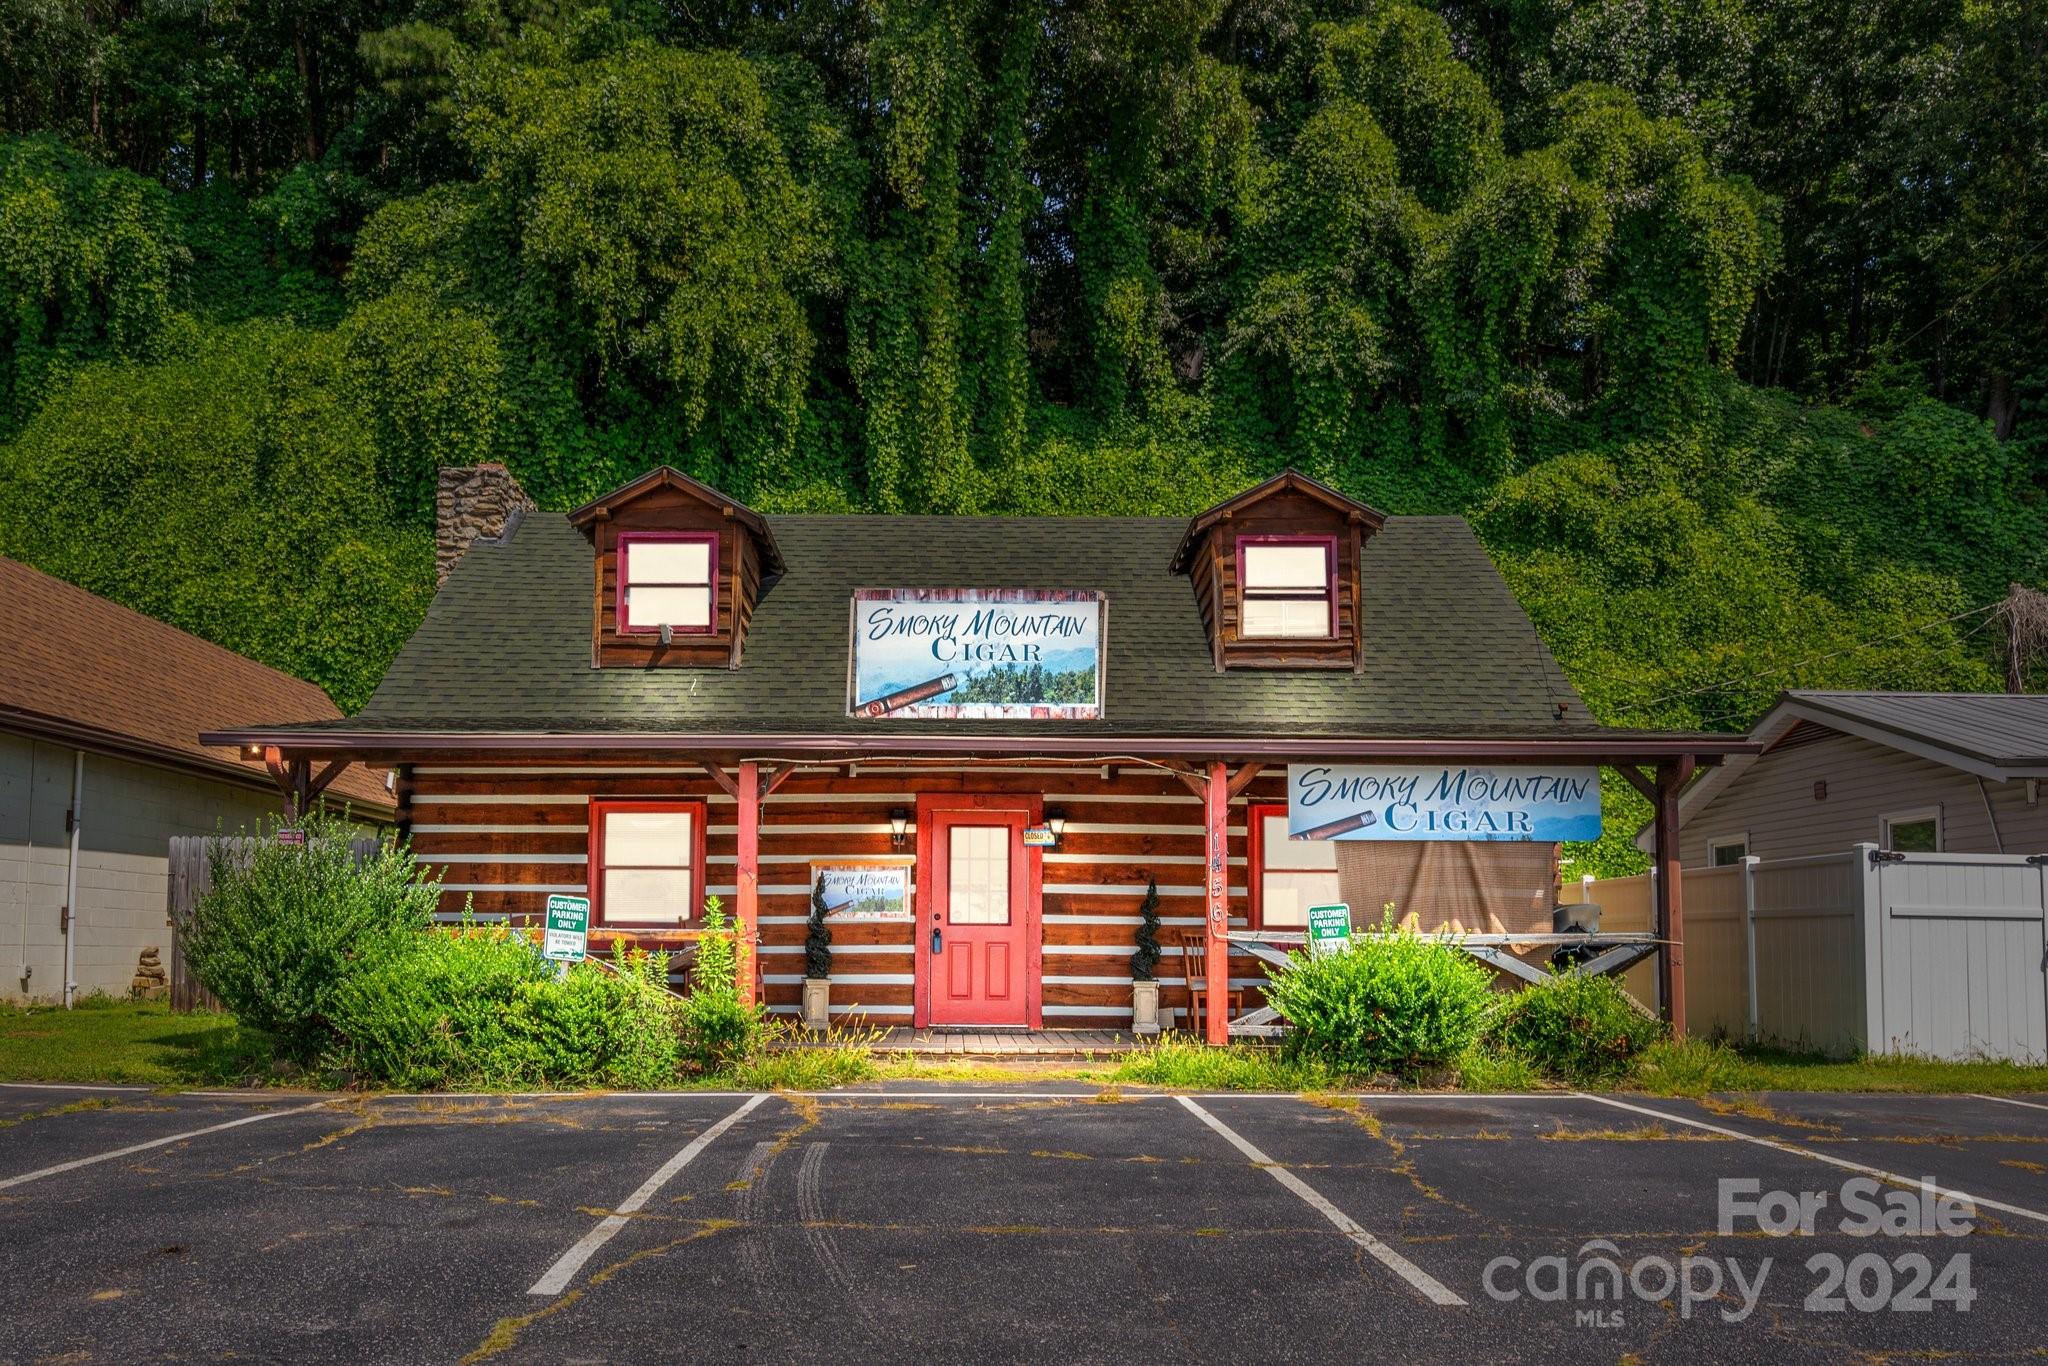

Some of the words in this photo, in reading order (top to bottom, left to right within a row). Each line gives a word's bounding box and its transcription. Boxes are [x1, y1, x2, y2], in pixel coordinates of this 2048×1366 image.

[868, 608, 958, 640] SMOKY
[963, 609, 1087, 639] MOUNTAIN
[931, 636, 1043, 662] CIGAR
[1299, 767, 1419, 806] SMOKY
[1426, 769, 1590, 805] MOUNTAIN
[1384, 802, 1533, 832] CIGAR
[1025, 831, 1044, 839] CLOSED
[856, 873, 900, 885] MOUNTAIN
[1212, 832, 1223, 922] 1456
[845, 885, 884, 895] CIGAR
[550, 900, 587, 912] CUSTOMER
[552, 910, 584, 921] PARKING
[1310, 909, 1347, 920] CUSTOMER
[558, 920, 576, 929] ONLY
[1314, 918, 1345, 928] PARKING
[1321, 928, 1340, 937] ONLY
